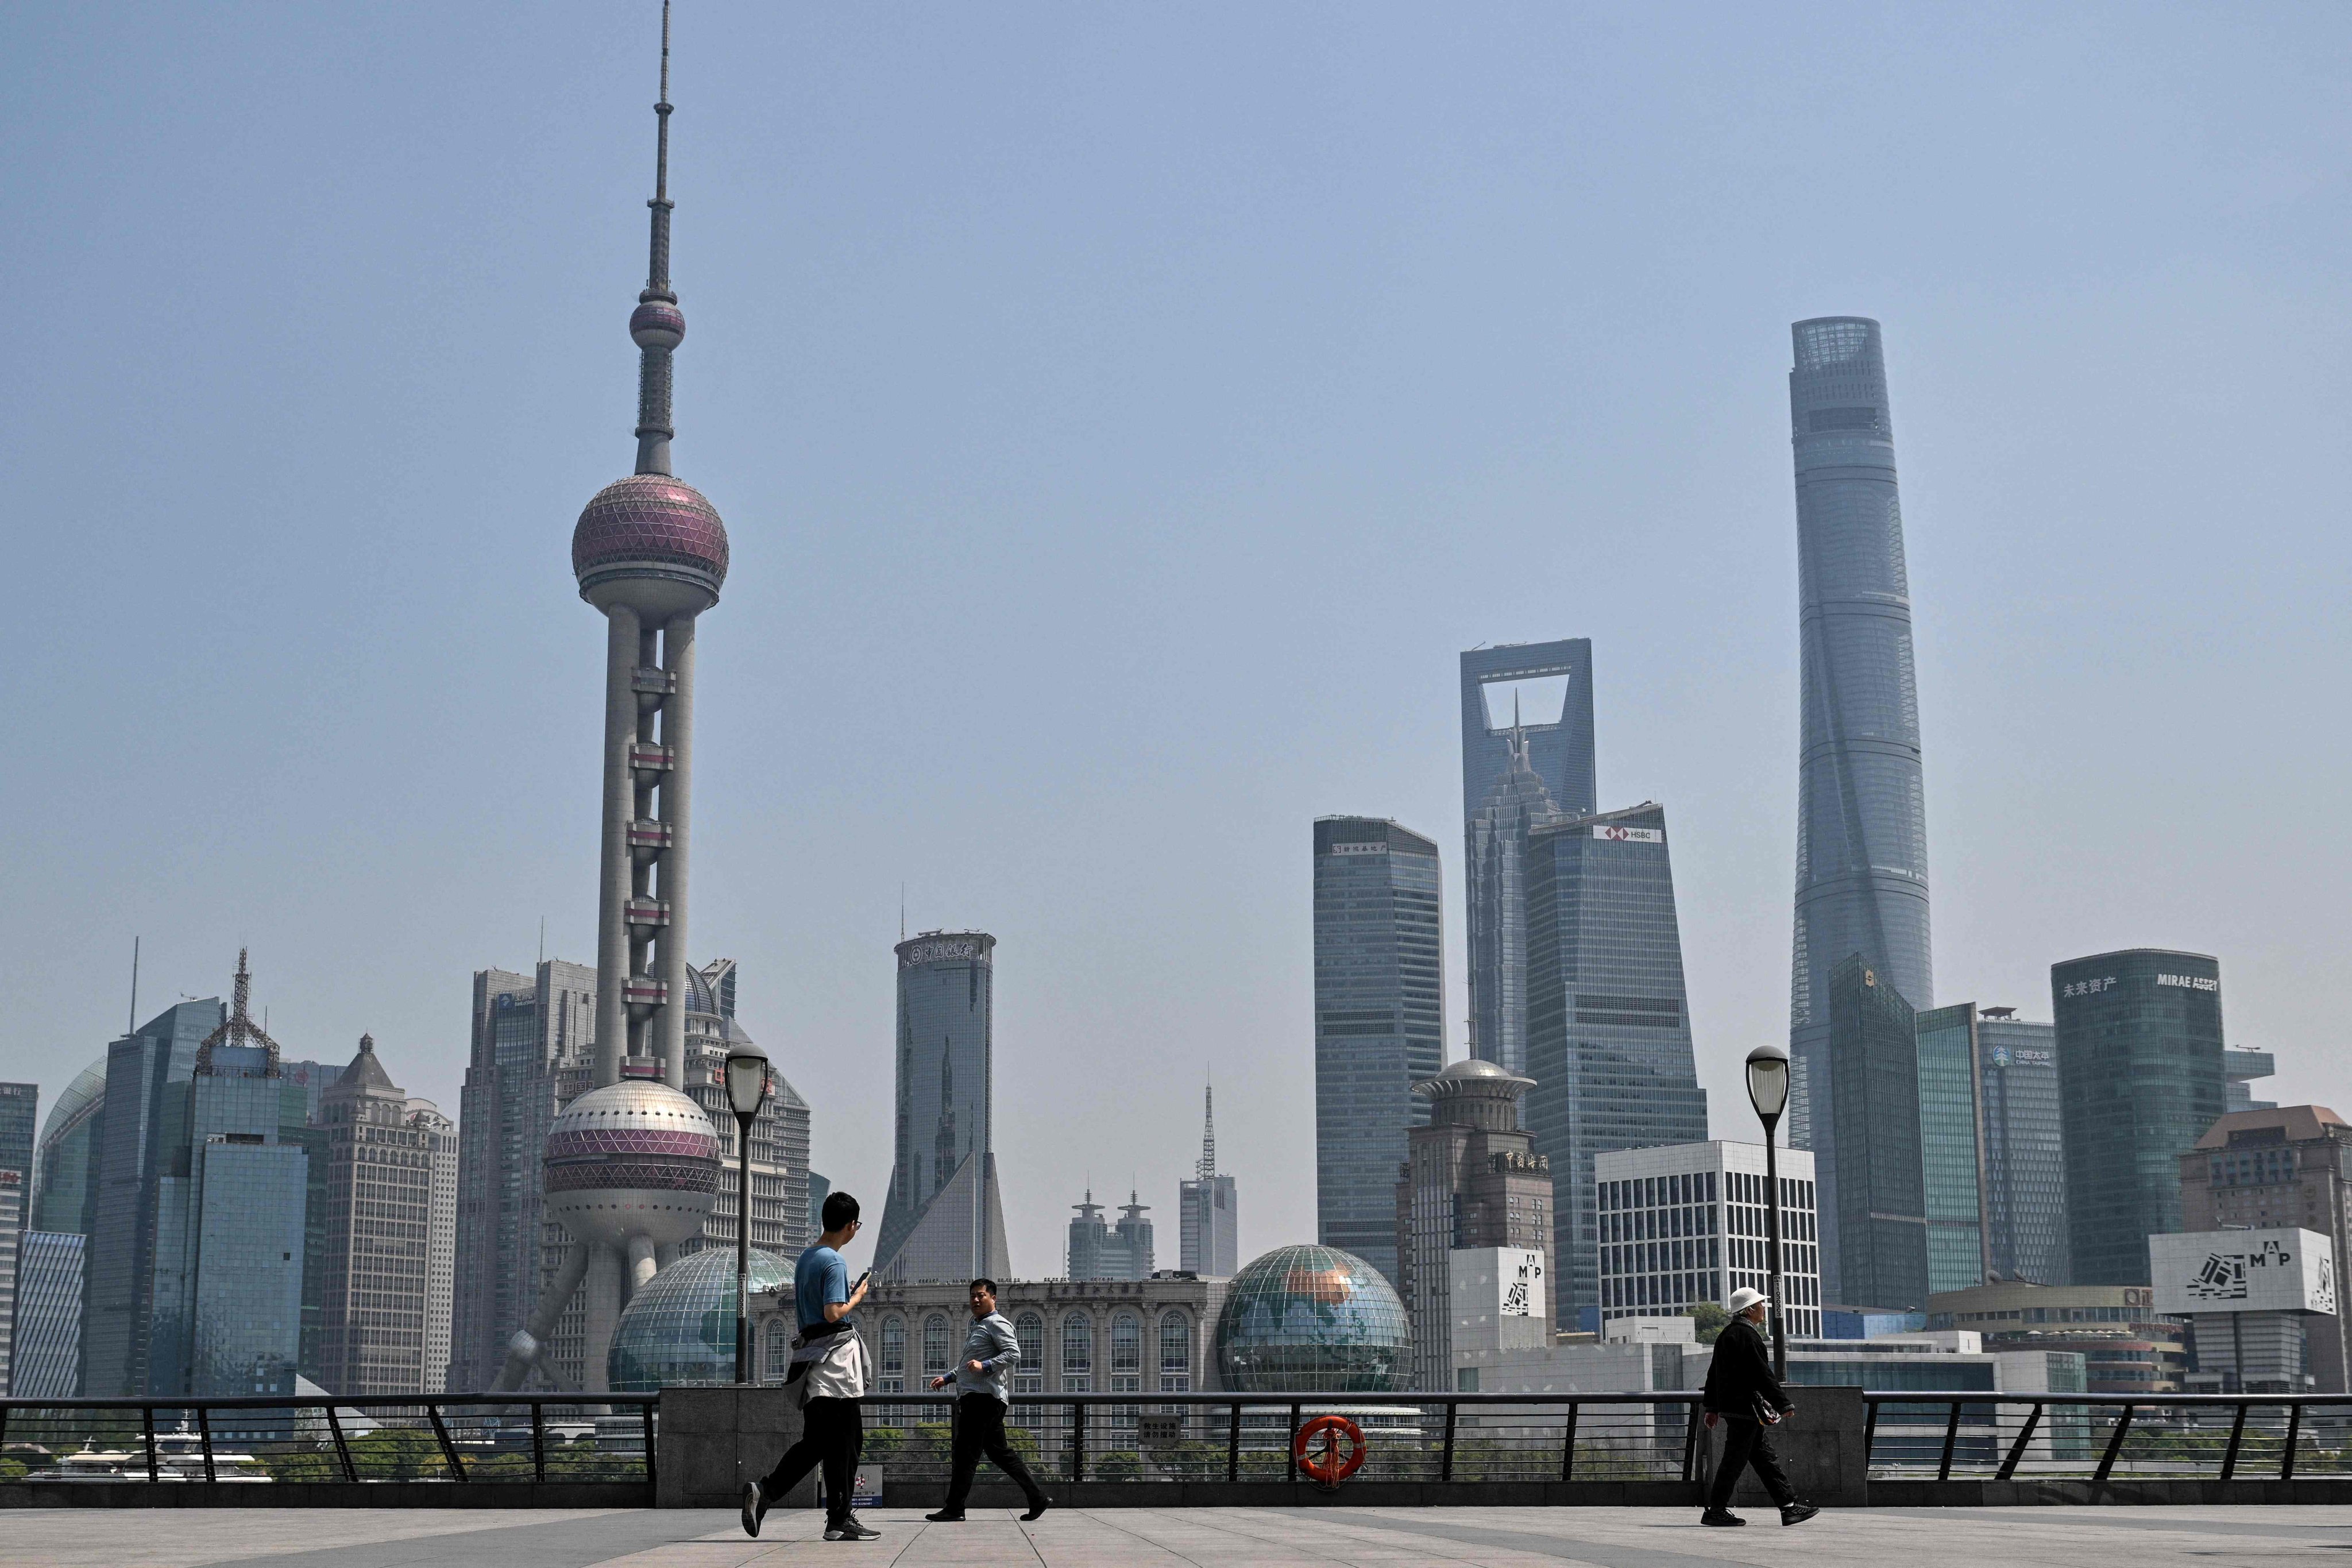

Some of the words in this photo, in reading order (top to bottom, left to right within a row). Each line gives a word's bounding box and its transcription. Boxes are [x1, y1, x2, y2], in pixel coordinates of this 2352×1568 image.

[1631, 831, 1651, 839] HSBC
[924, 943, 974, 961] 中国银行
[2064, 976, 2117, 998] 未来资产
[2157, 974, 2191, 988] MIRAE
[2192, 977, 2218, 991] ASSET
[2015, 1050, 2049, 1060] 中国太平
